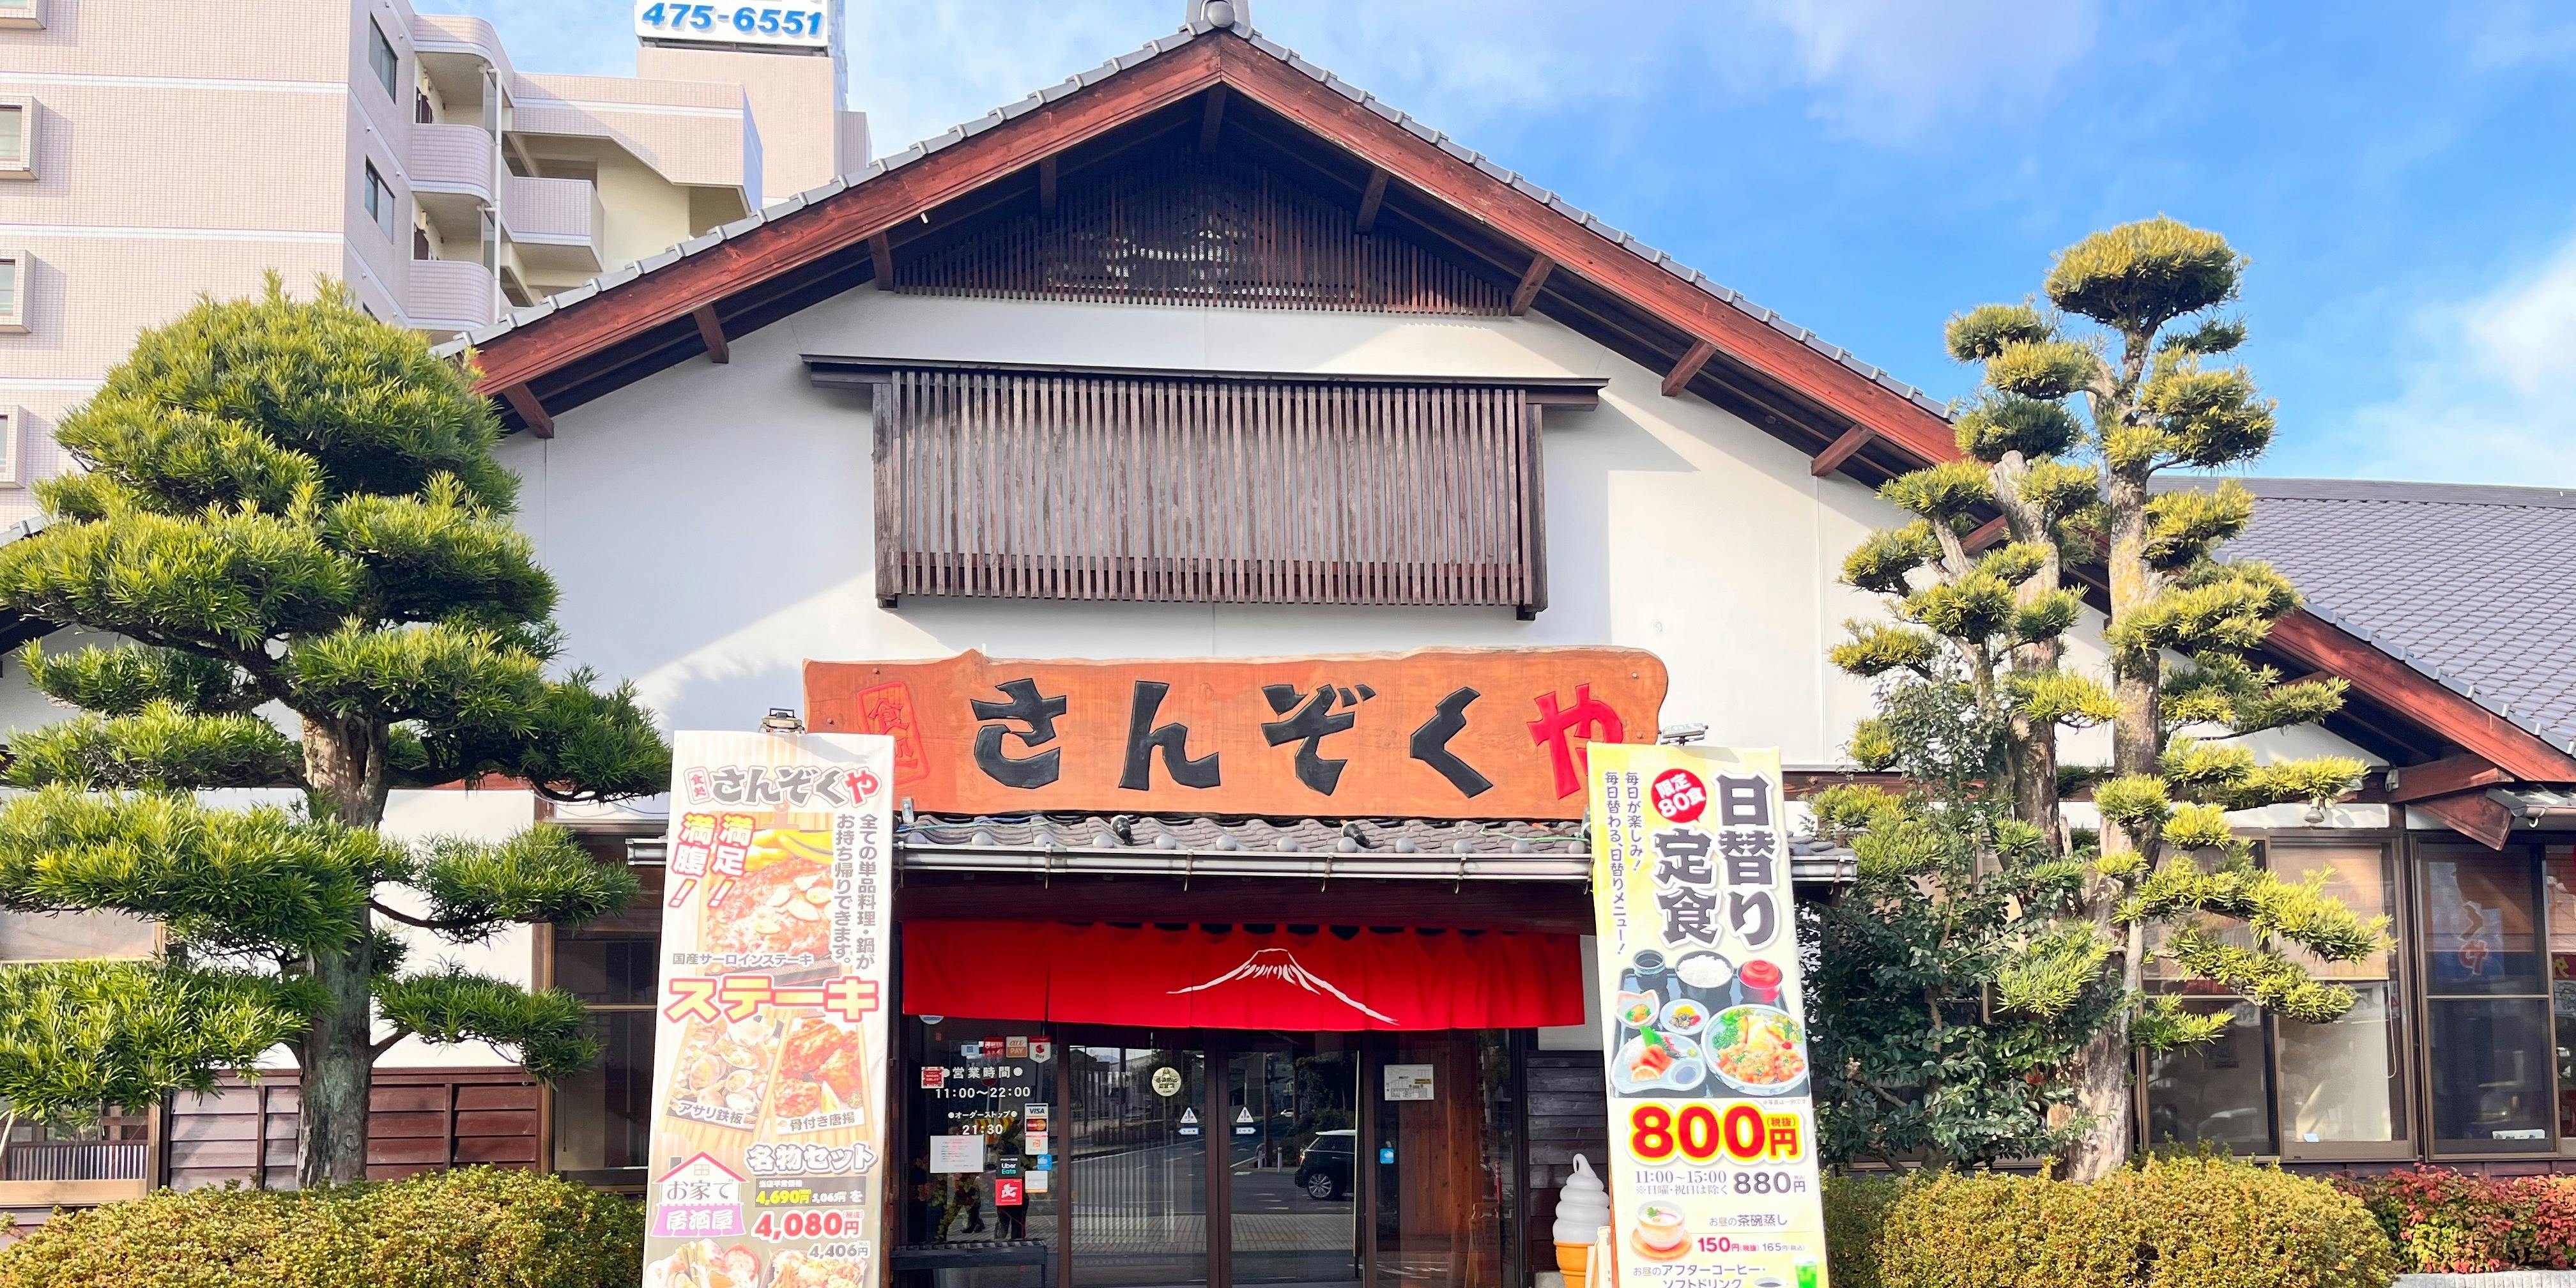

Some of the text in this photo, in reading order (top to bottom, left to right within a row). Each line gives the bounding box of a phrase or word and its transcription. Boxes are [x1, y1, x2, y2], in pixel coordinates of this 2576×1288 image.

[641, 3, 822, 36] 475-6551
[970, 677, 1624, 800] さんぞくや
[712, 768, 878, 804] さんぞくや
[1655, 773, 1691, 799] 限定
[1658, 787, 1706, 817] 80食
[1625, 772, 1643, 871] 毎日が楽しみ！
[1717, 774, 1775, 946] 日替り
[832, 813, 855, 963] お持ち帰りできます。
[855, 813, 878, 970] 全ての単品料理・鍋が
[1653, 828, 1718, 944] 定食
[672, 953, 813, 966] 国産サーロインステーキ
[663, 976, 879, 1023] ステーキ
[953, 1066, 1010, 1078] 営業時間
[677, 1103, 746, 1124] アサリ鉄板
[790, 1111, 855, 1131] 骨付き唐揚
[954, 1110, 1011, 1118] オーダーストップ
[962, 1124, 1003, 1135] 21:30
[1632, 1106, 1798, 1158] 800円
[747, 1144, 874, 1172] 名物セット
[667, 1179, 733, 1200] お家で
[1733, 1172, 1805, 1194] 880円
[666, 1209, 733, 1230] 居酒屋
[755, 1213, 859, 1240] 4,080円
[1709, 1215, 1788, 1227] お昼の茶碗蒸し
[809, 1245, 868, 1259] 4,406円
